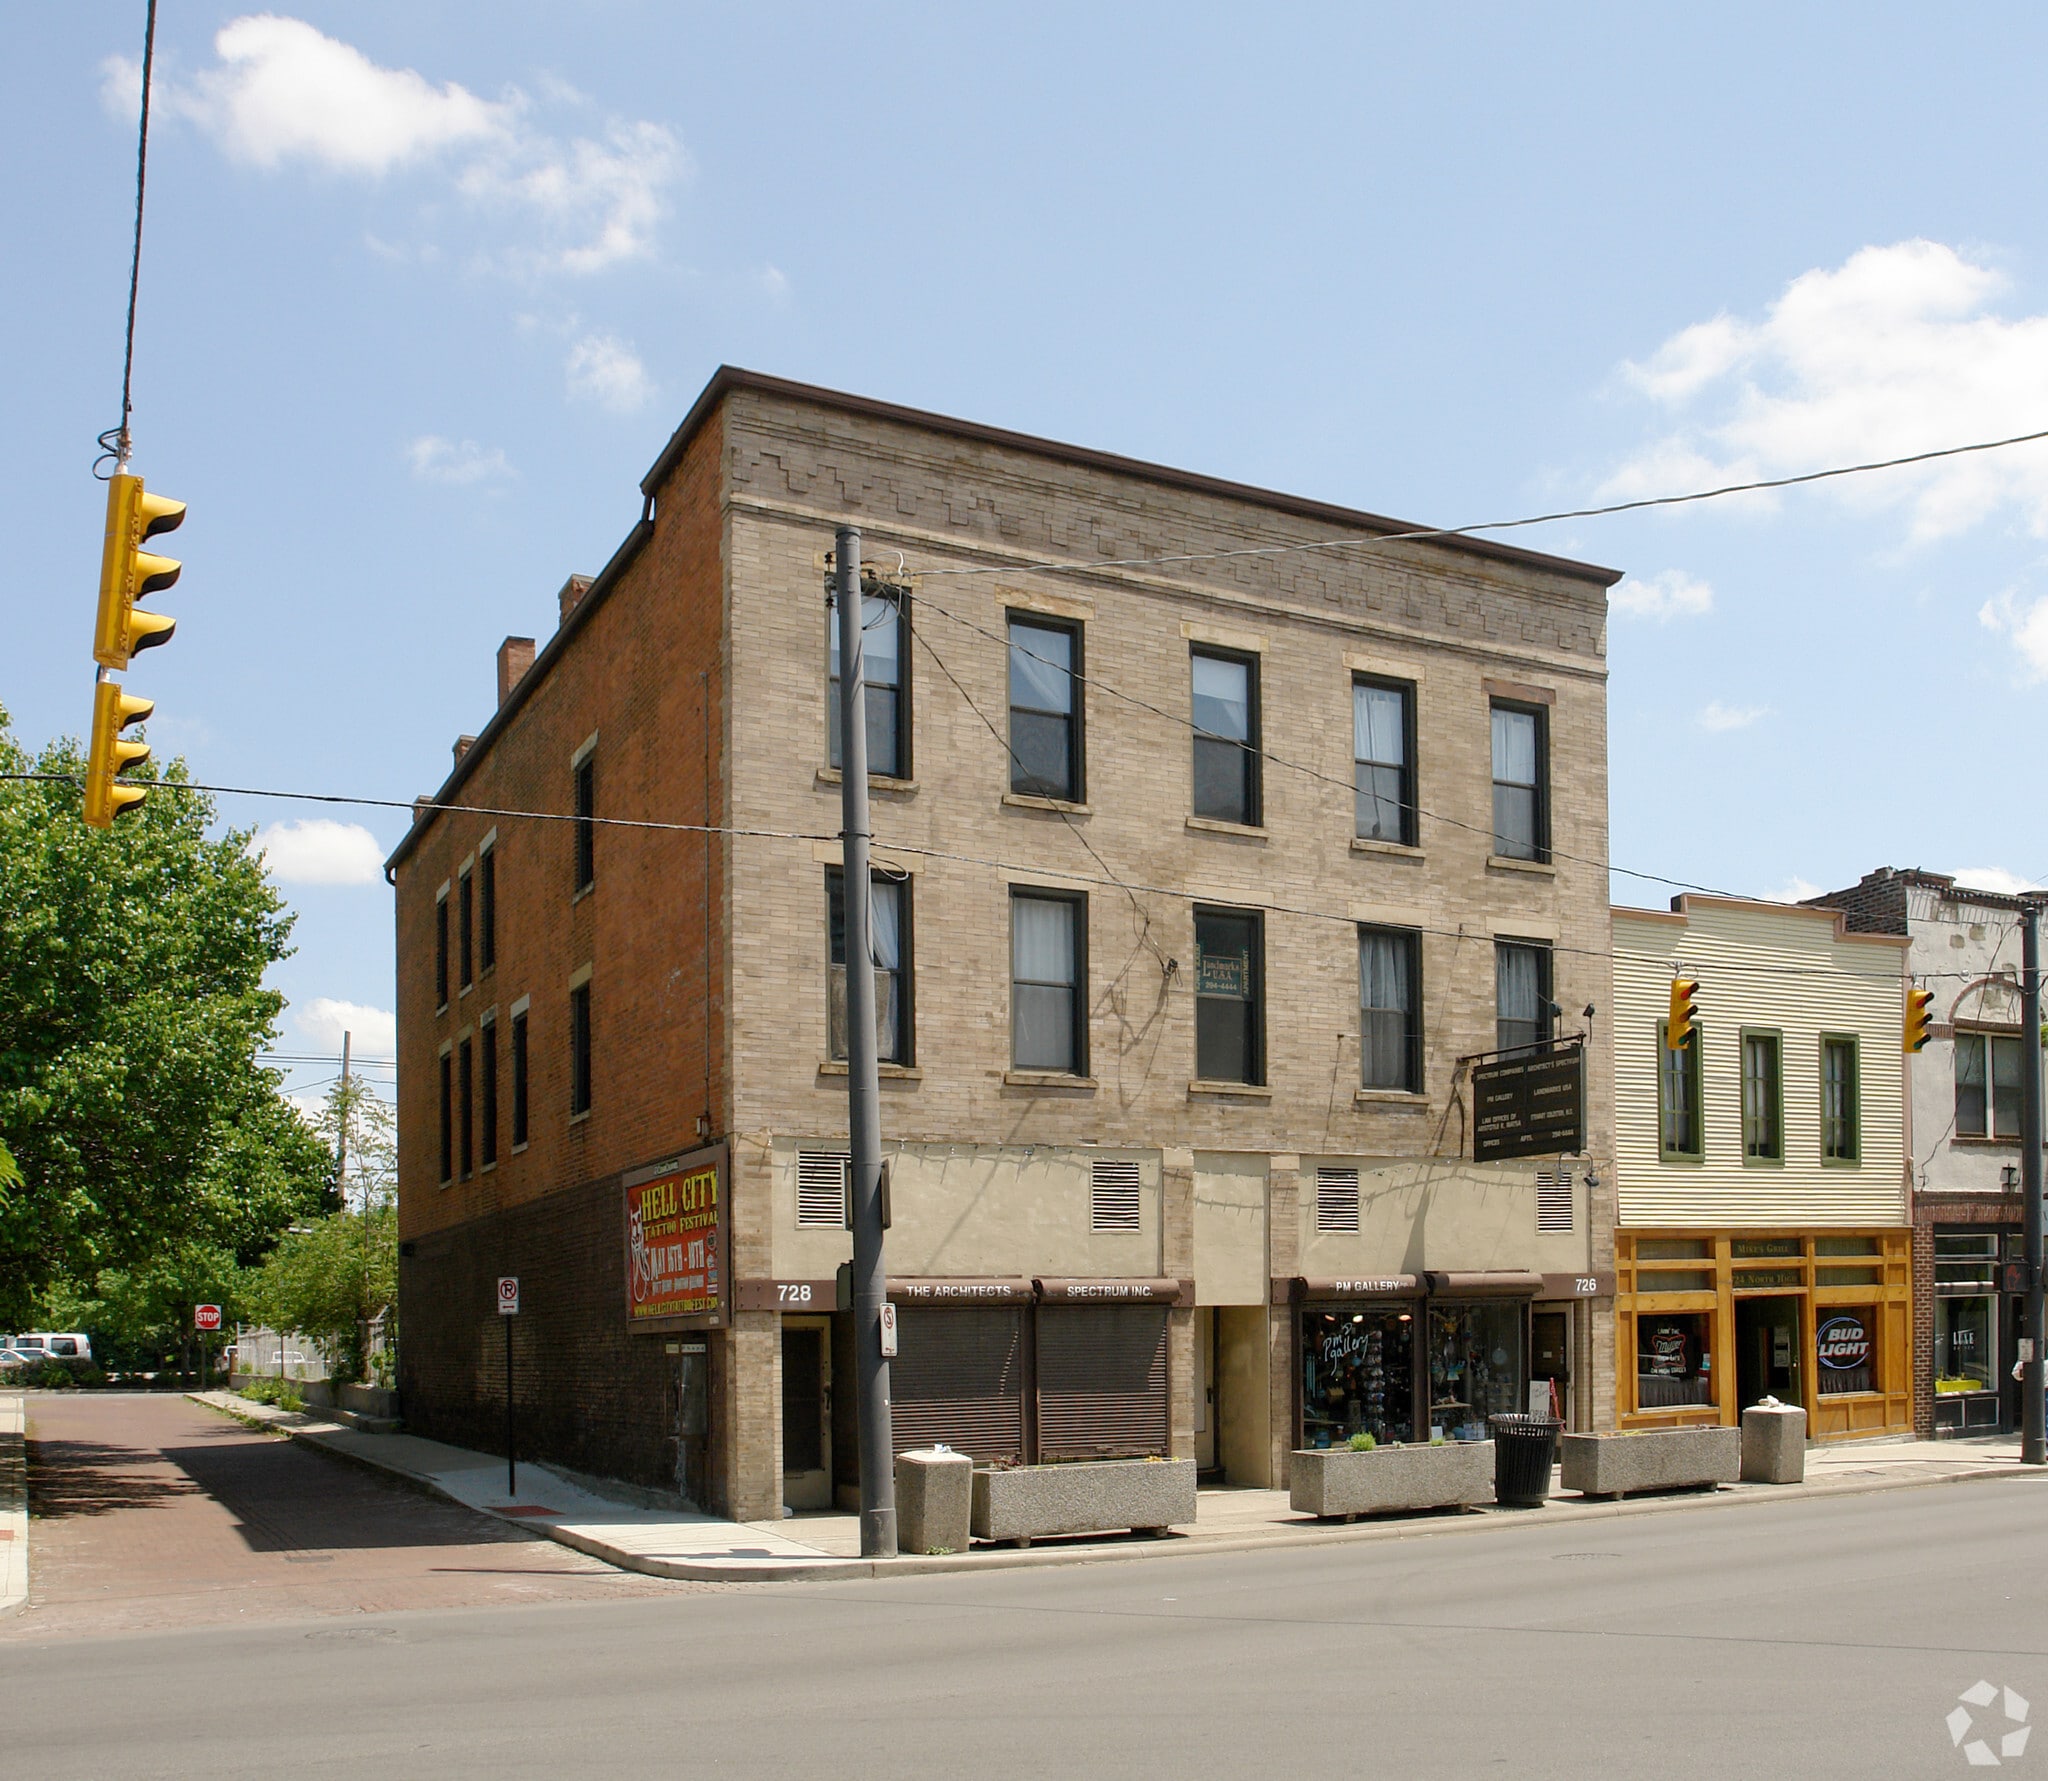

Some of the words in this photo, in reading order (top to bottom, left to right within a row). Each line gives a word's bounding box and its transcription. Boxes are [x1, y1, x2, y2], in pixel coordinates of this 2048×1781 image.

[642, 1182, 678, 1222] HELL
[682, 1170, 718, 1212] CITY
[643, 1220, 677, 1242] TATTOO
[680, 1210, 718, 1234] FESTIVAL
[906, 1285, 931, 1297] THE
[934, 1285, 1011, 1297] ARCHITECTS
[1067, 1285, 1129, 1297] SPECTRUM
[1131, 1285, 1154, 1297] INC.
[1336, 1280, 1351, 1292] PM
[1354, 1280, 1400, 1292] GALLERY
[1575, 1277, 1597, 1292] 726
[777, 1284, 812, 1302] 728
[197, 1311, 220, 1322] STOP
[1827, 1327, 1865, 1342] BUD
[1330, 1334, 1369, 1377] gallery
[1818, 1342, 1870, 1357] LIGHT
